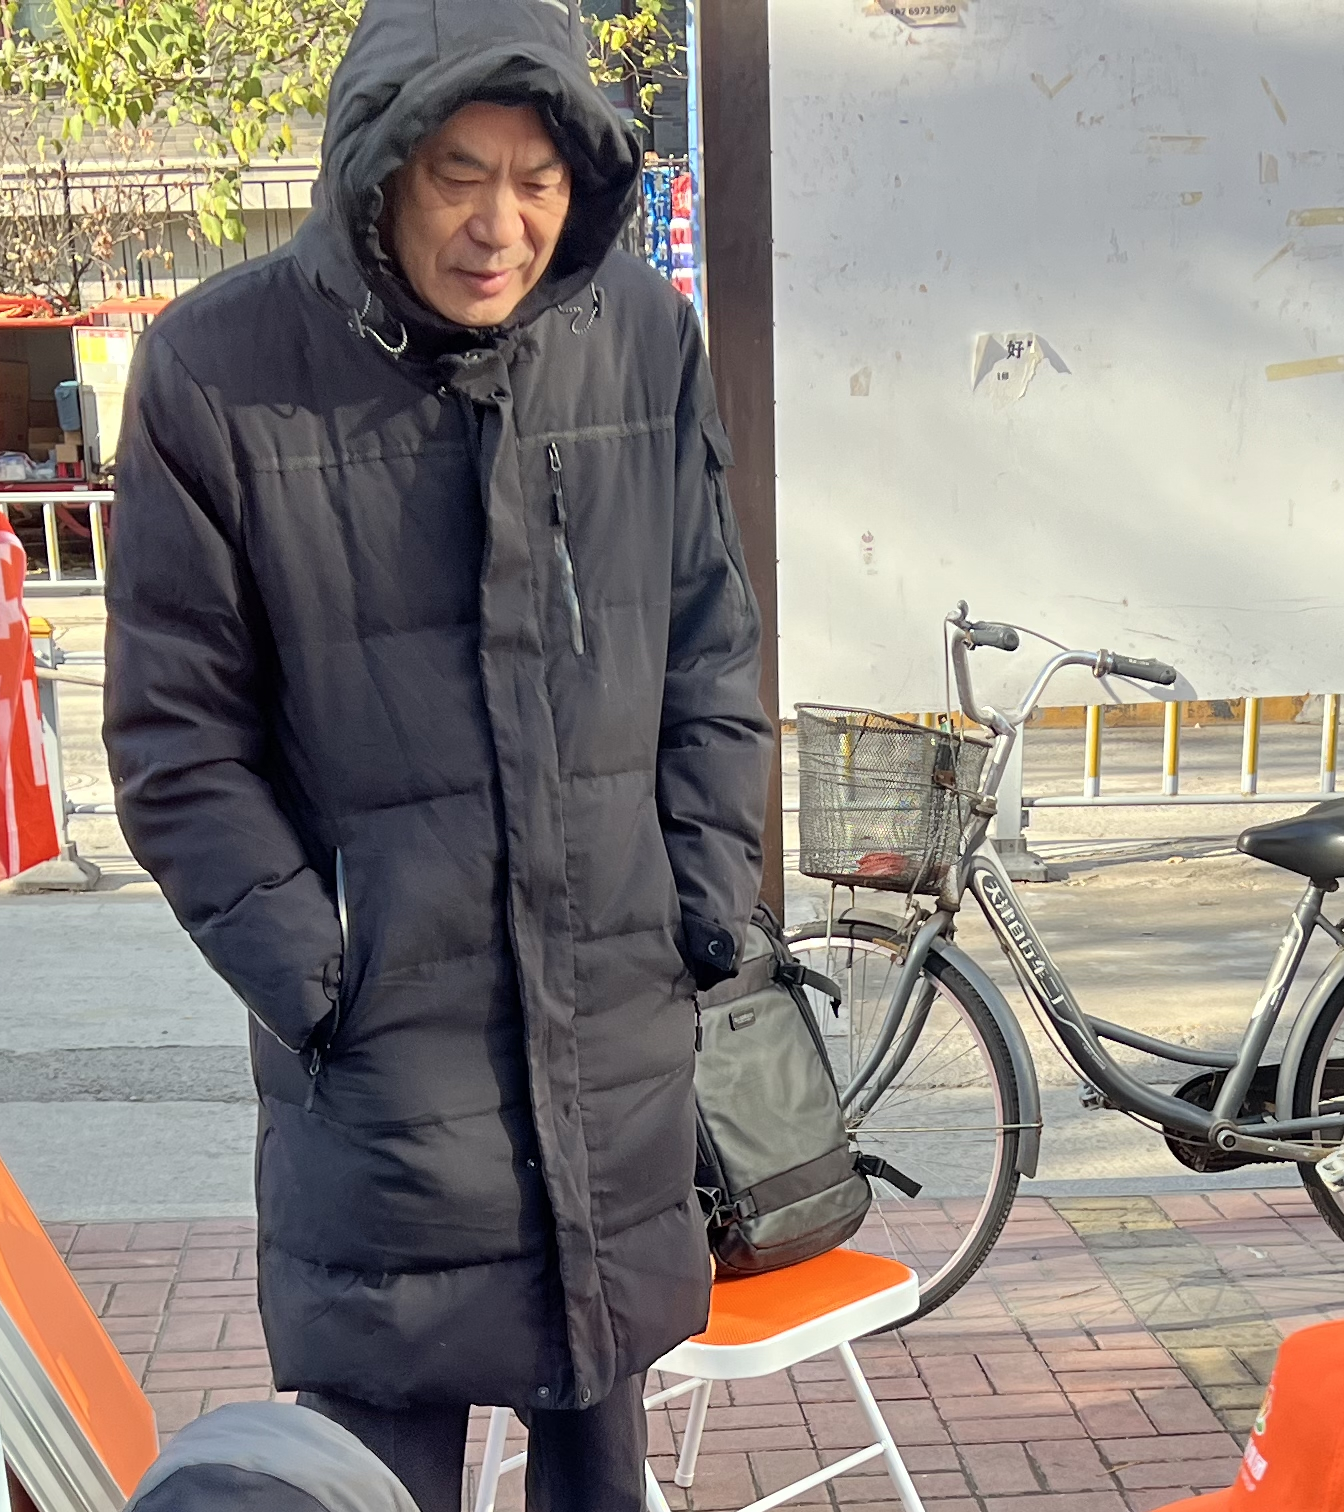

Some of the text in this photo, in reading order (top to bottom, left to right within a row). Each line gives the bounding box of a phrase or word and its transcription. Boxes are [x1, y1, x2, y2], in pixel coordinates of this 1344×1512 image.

[908, 6, 931, 16] 6972
[933, 5, 956, 14] 5090
[1006, 339, 1033, 360] 好
[983, 879, 1074, 1013] 天津自行车二厂
